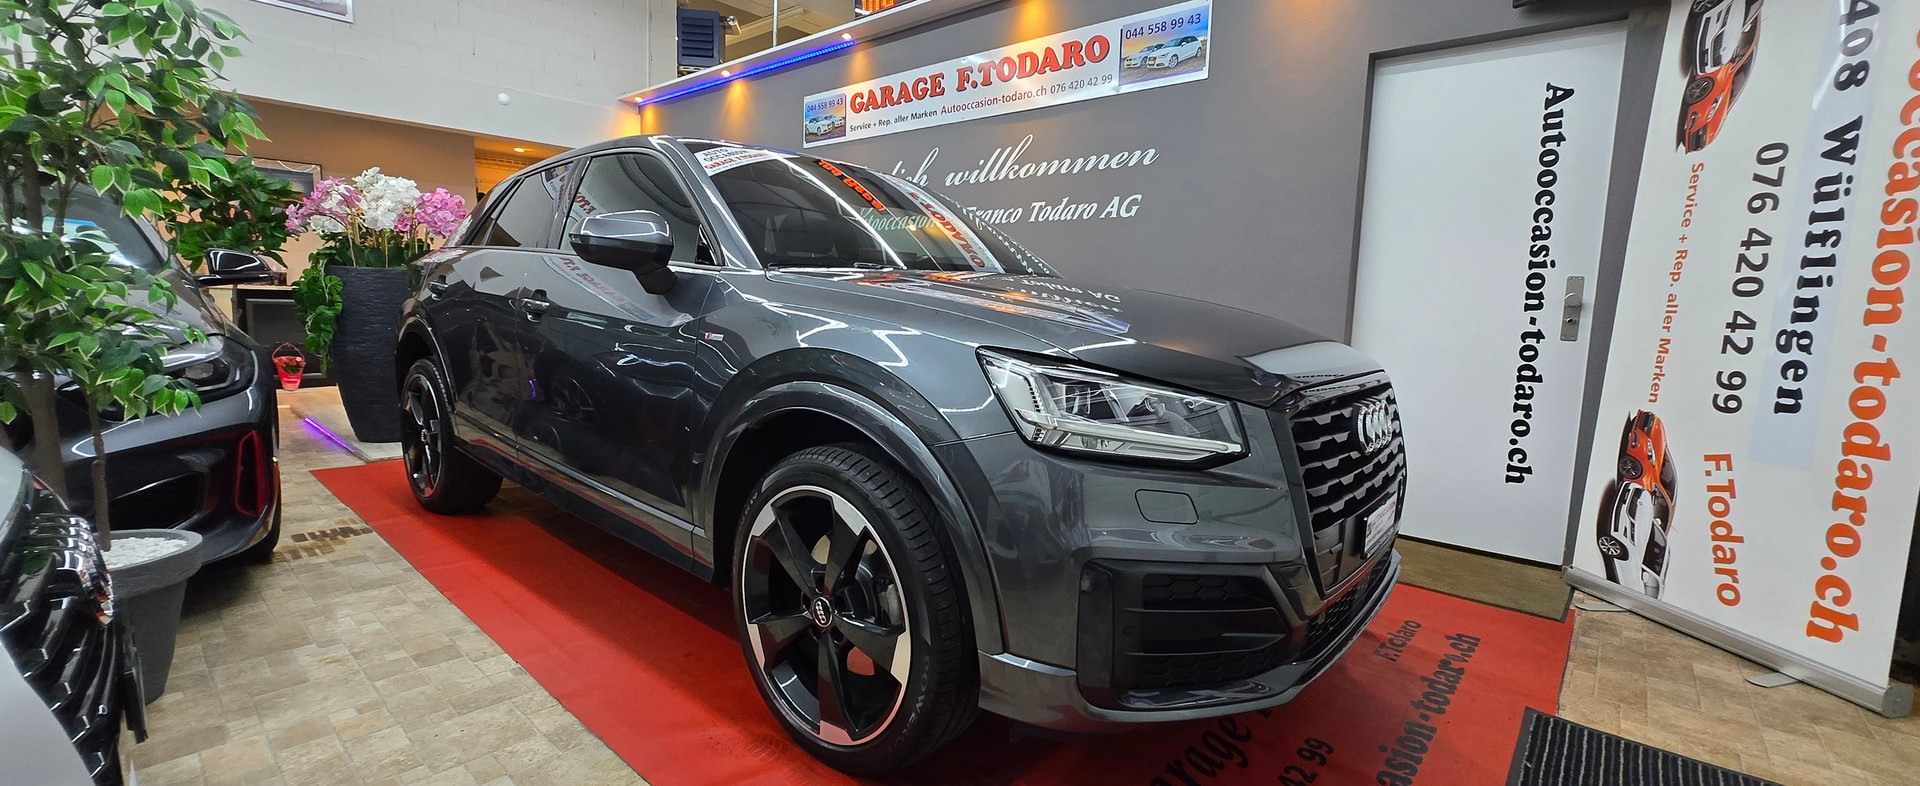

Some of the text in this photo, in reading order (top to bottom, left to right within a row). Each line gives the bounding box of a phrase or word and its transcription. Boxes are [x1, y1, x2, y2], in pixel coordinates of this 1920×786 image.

[1125, 13, 1202, 40] 044 558 99 43
[806, 97, 844, 114] 044 558 99 43
[849, 121, 872, 132] Service
[878, 118, 893, 128] Rep.
[893, 115, 909, 124] aller
[910, 109, 938, 121] Marken
[940, 85, 1048, 115] Autooccasion-todaro.ch
[1050, 81, 1067, 94] 076
[1068, 79, 1085, 91] 420
[1087, 76, 1099, 88] 42
[1101, 73, 1113, 85] 99
[850, 35, 1110, 114] GARAGE F.TODARO
[944, 134, 1160, 186] willkommen
[1028, 196, 1098, 223] Todaro
[1099, 194, 1143, 219] AG
[1504, 81, 1575, 484] Autooccasion-todaro.ch
[1648, 162, 1704, 403] Service + Rep. aller Marken
[1712, 142, 1789, 415] 076 420 42 99
[1773, 115, 1864, 415] Wülflingen
[1806, 28, 1920, 644] ccasion-todaro.ch
[1703, 453, 1745, 607] F.Todaro
[1295, 737, 1335, 766] 99
